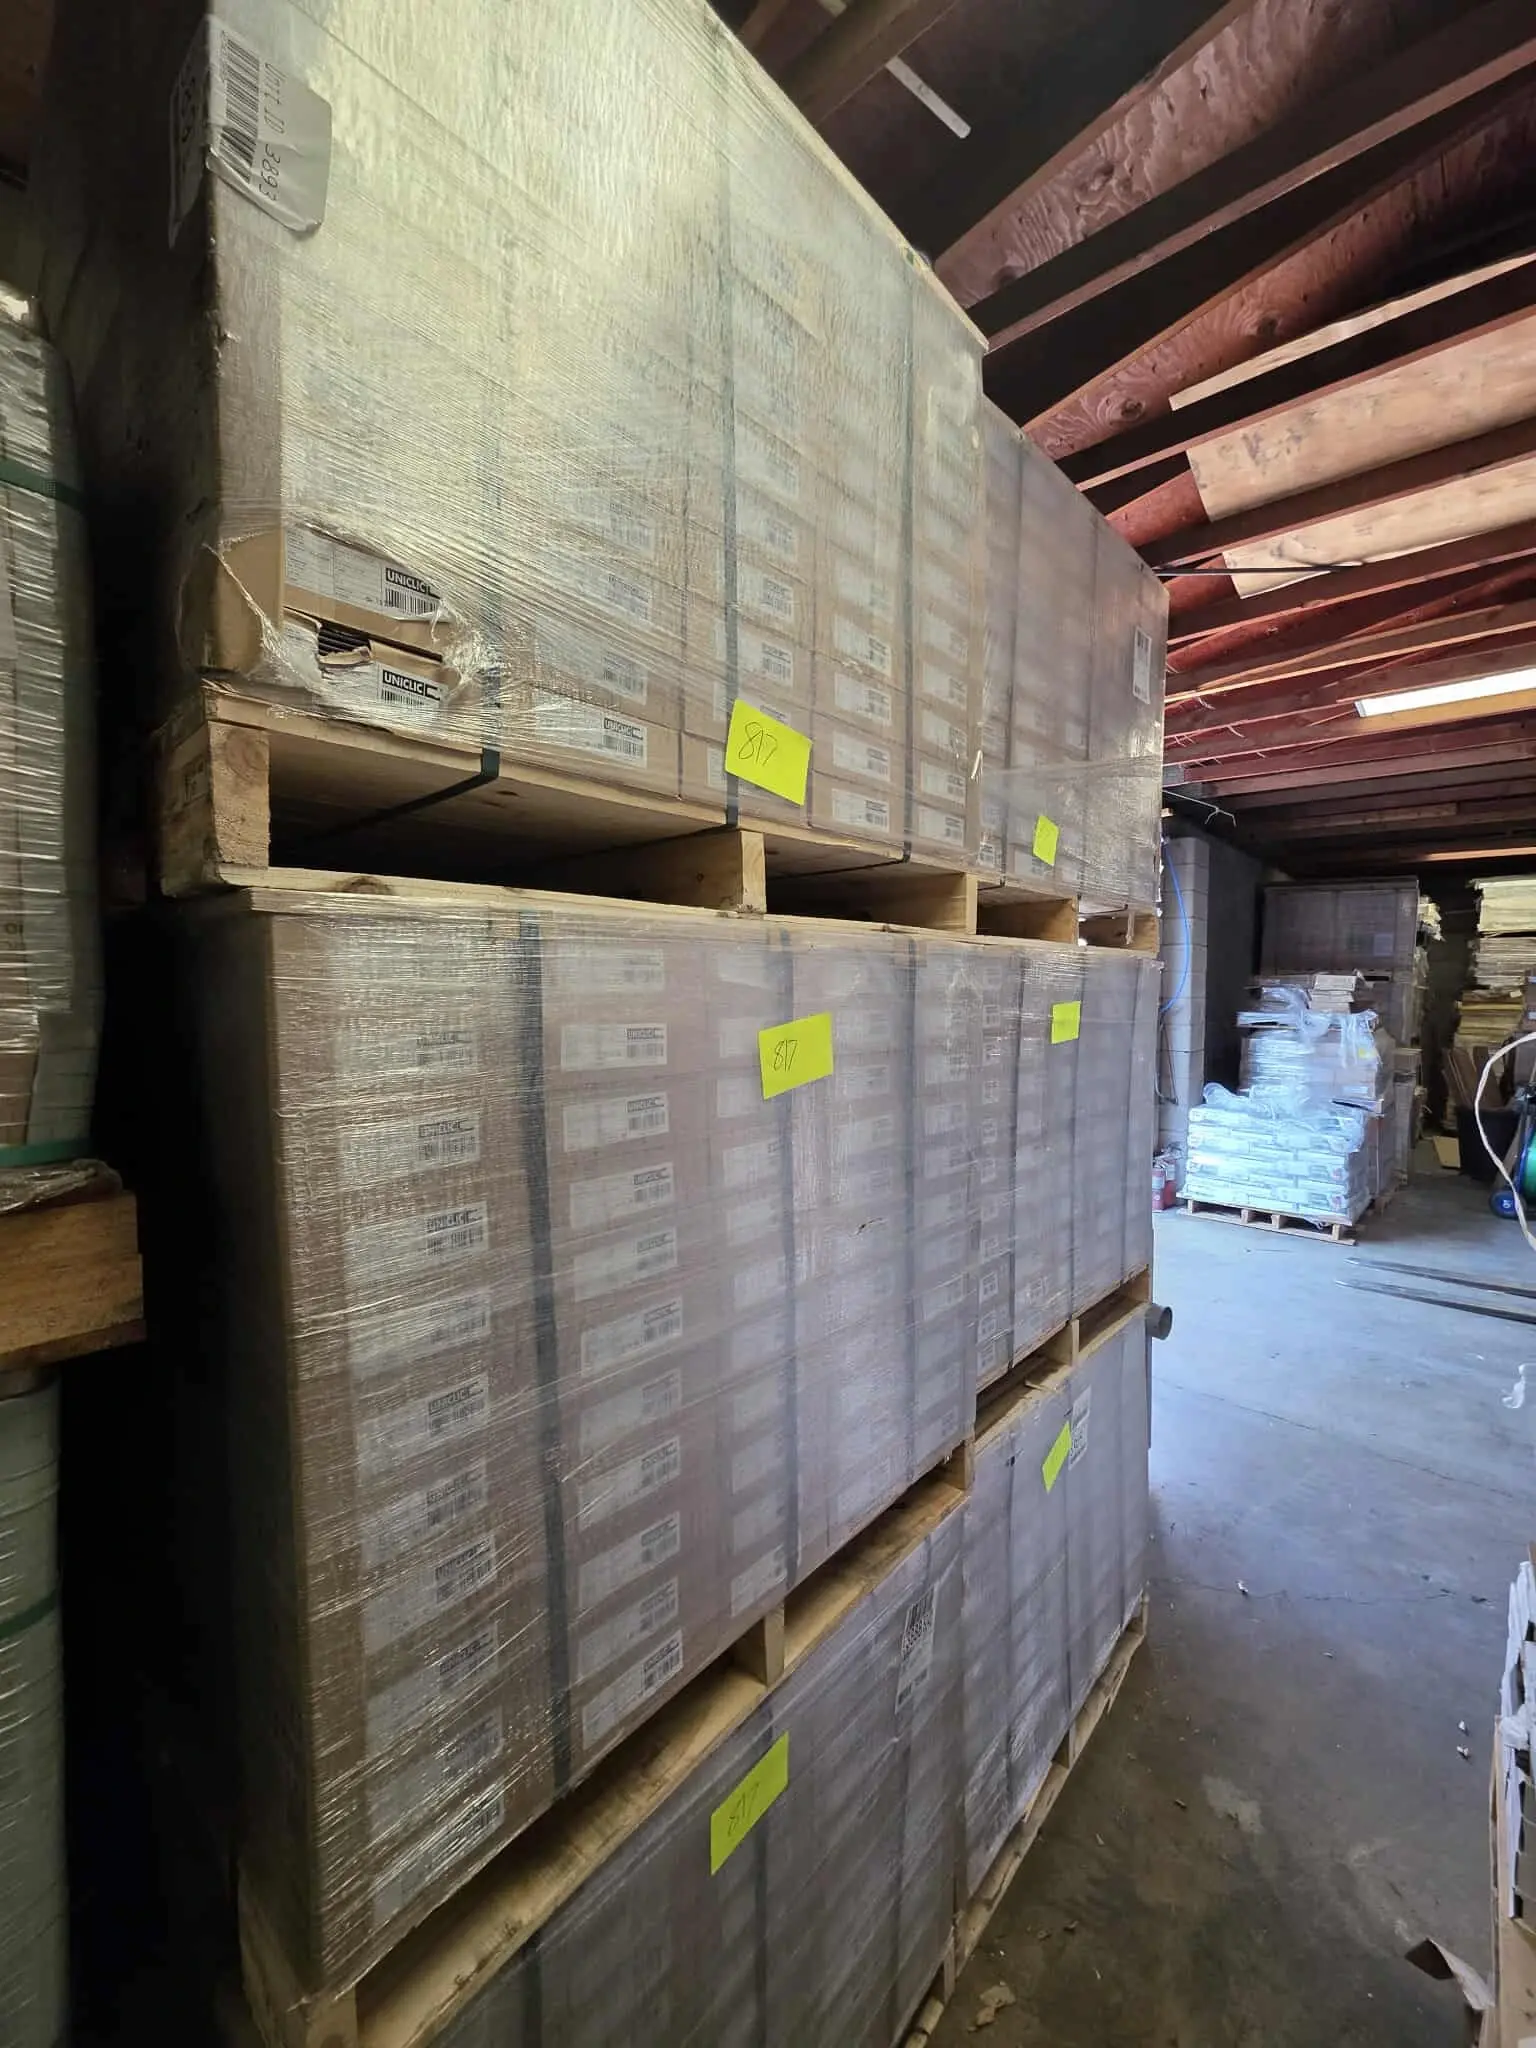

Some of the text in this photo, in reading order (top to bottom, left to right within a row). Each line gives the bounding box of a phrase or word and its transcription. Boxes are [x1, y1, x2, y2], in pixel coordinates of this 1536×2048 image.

[264, 106, 286, 135] ID
[258, 143, 282, 201] 3893
[387, 569, 426, 593] UNICLIC
[384, 671, 423, 694] UNICLIC
[738, 721, 779, 767] 817
[773, 1039, 798, 1072] 817
